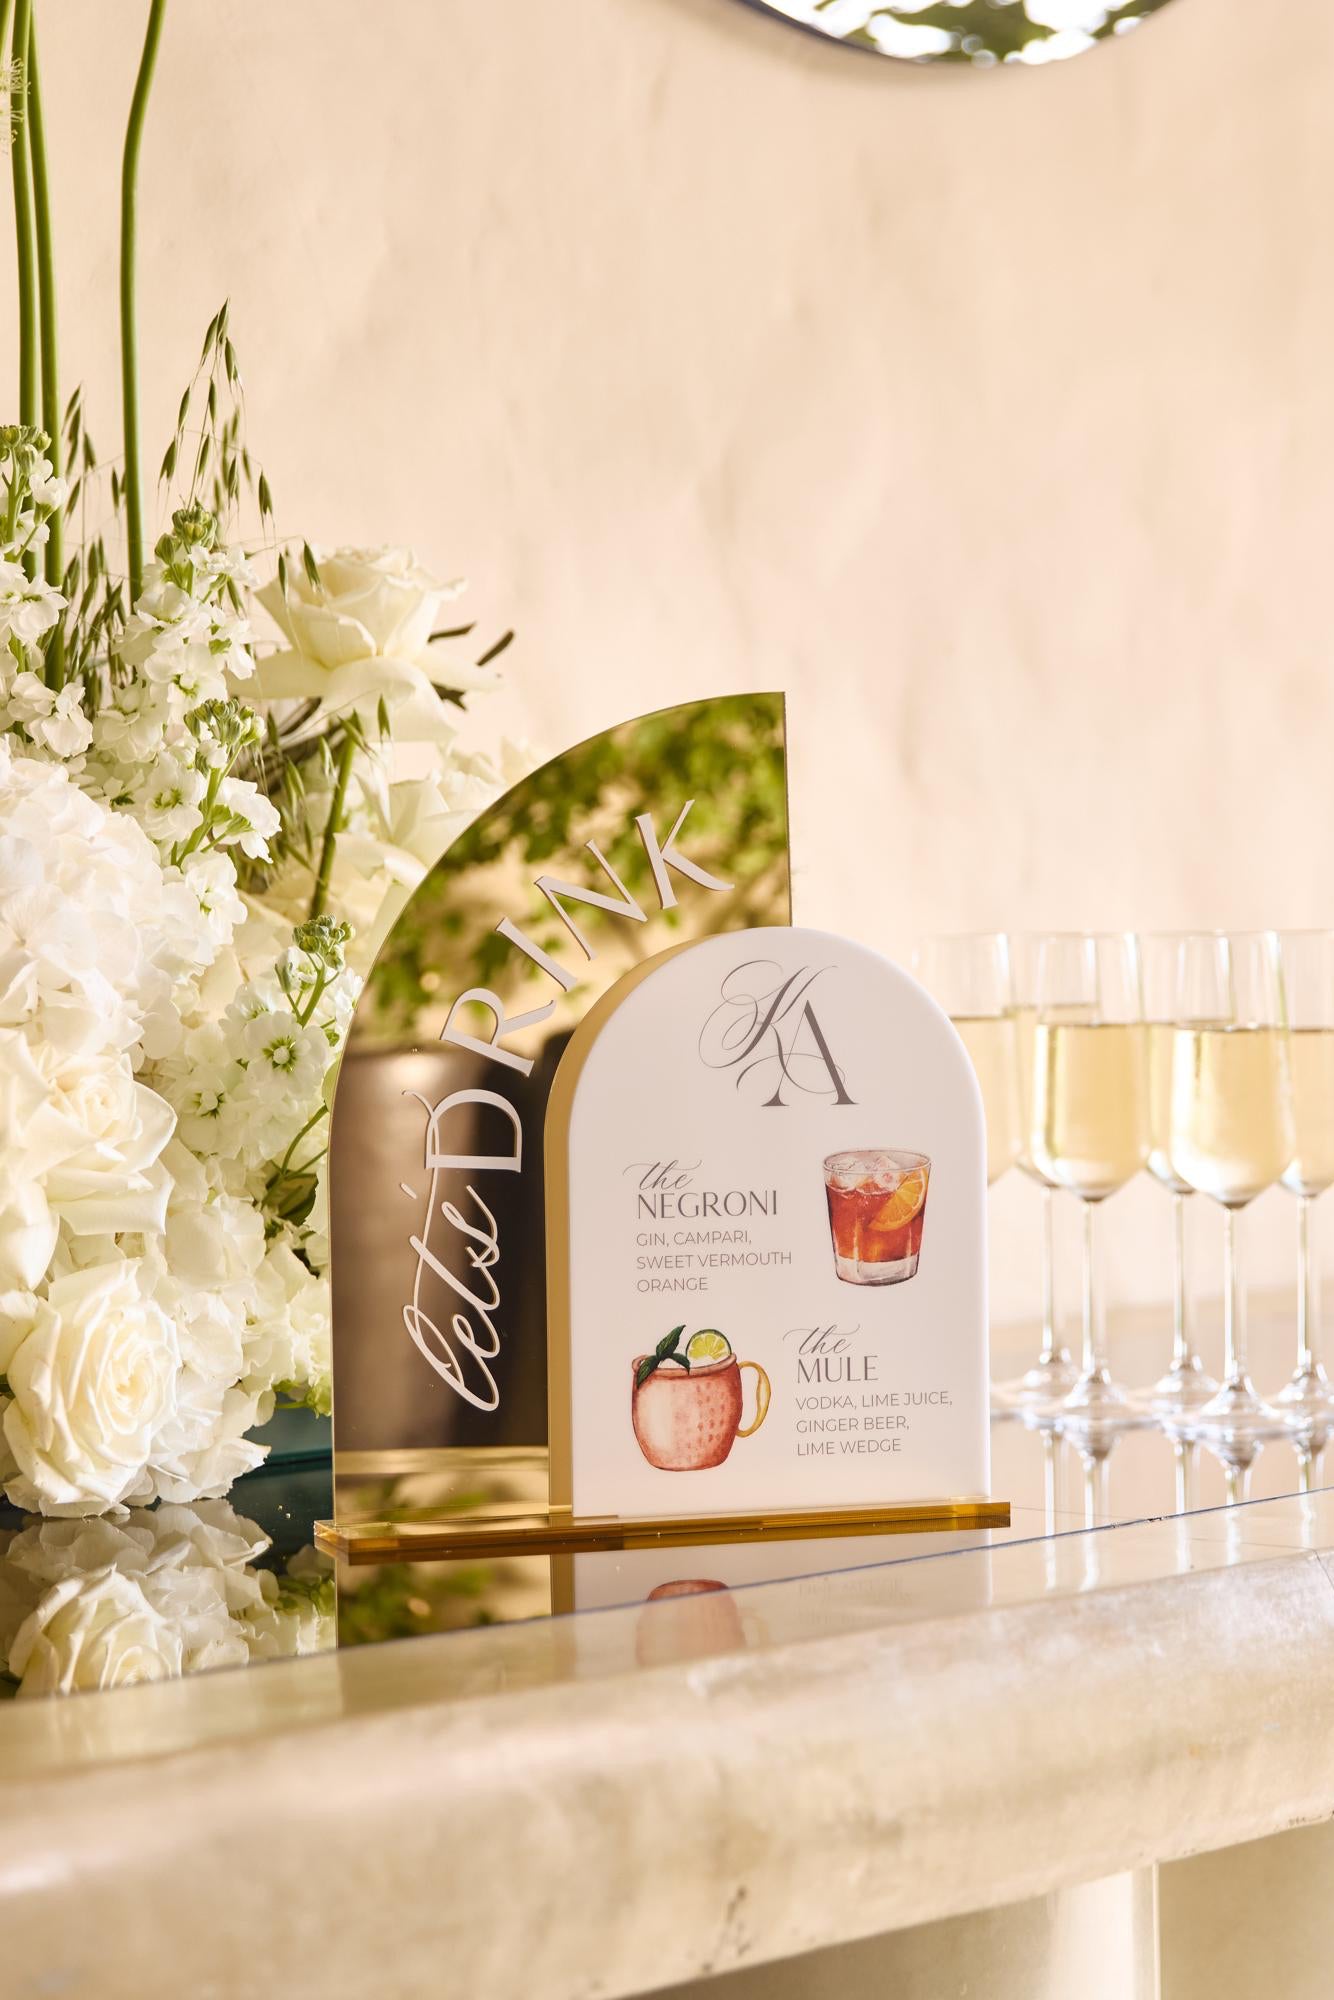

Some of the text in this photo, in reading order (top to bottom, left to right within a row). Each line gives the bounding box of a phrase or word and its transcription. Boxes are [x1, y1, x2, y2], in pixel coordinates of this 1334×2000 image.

[424, 800, 734, 1173] DRINK
[623, 1159, 702, 1191] the
[637, 1189, 778, 1220] NEGRONI
[636, 1230, 752, 1248] GIN, CAMPARI,
[636, 1251, 793, 1270] SWEET VERMOUTH
[636, 1277, 709, 1293] ORANGE
[782, 1324, 861, 1356] the
[797, 1355, 879, 1384] MULE
[795, 1391, 953, 1411] VODKA, LIME JUICE,
[796, 1415, 910, 1434] GINGER BEER,
[797, 1438, 902, 1457] LIME WEDGE
